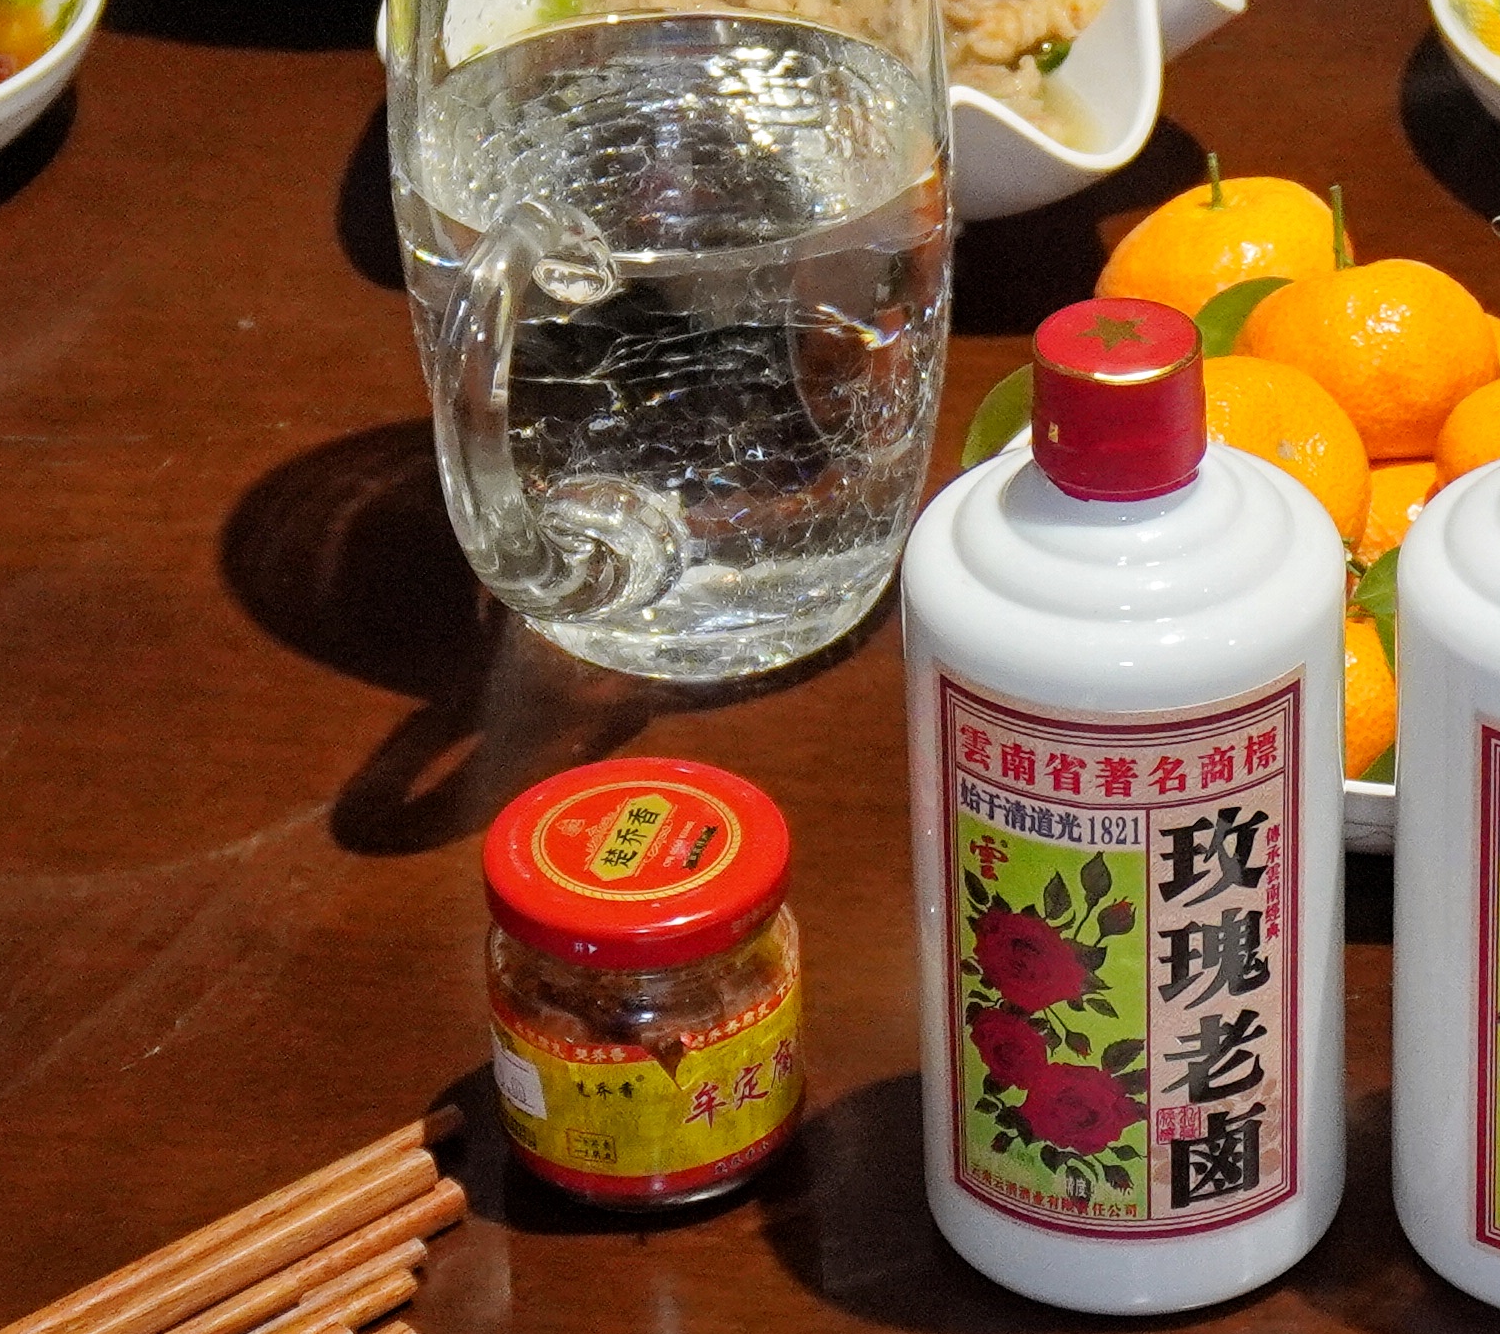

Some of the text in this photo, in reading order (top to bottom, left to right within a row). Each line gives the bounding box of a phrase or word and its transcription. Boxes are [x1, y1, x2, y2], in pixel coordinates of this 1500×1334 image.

[960, 724, 1278, 798] 雲南省著名商標
[960, 778, 1142, 845] 始于清道光1821
